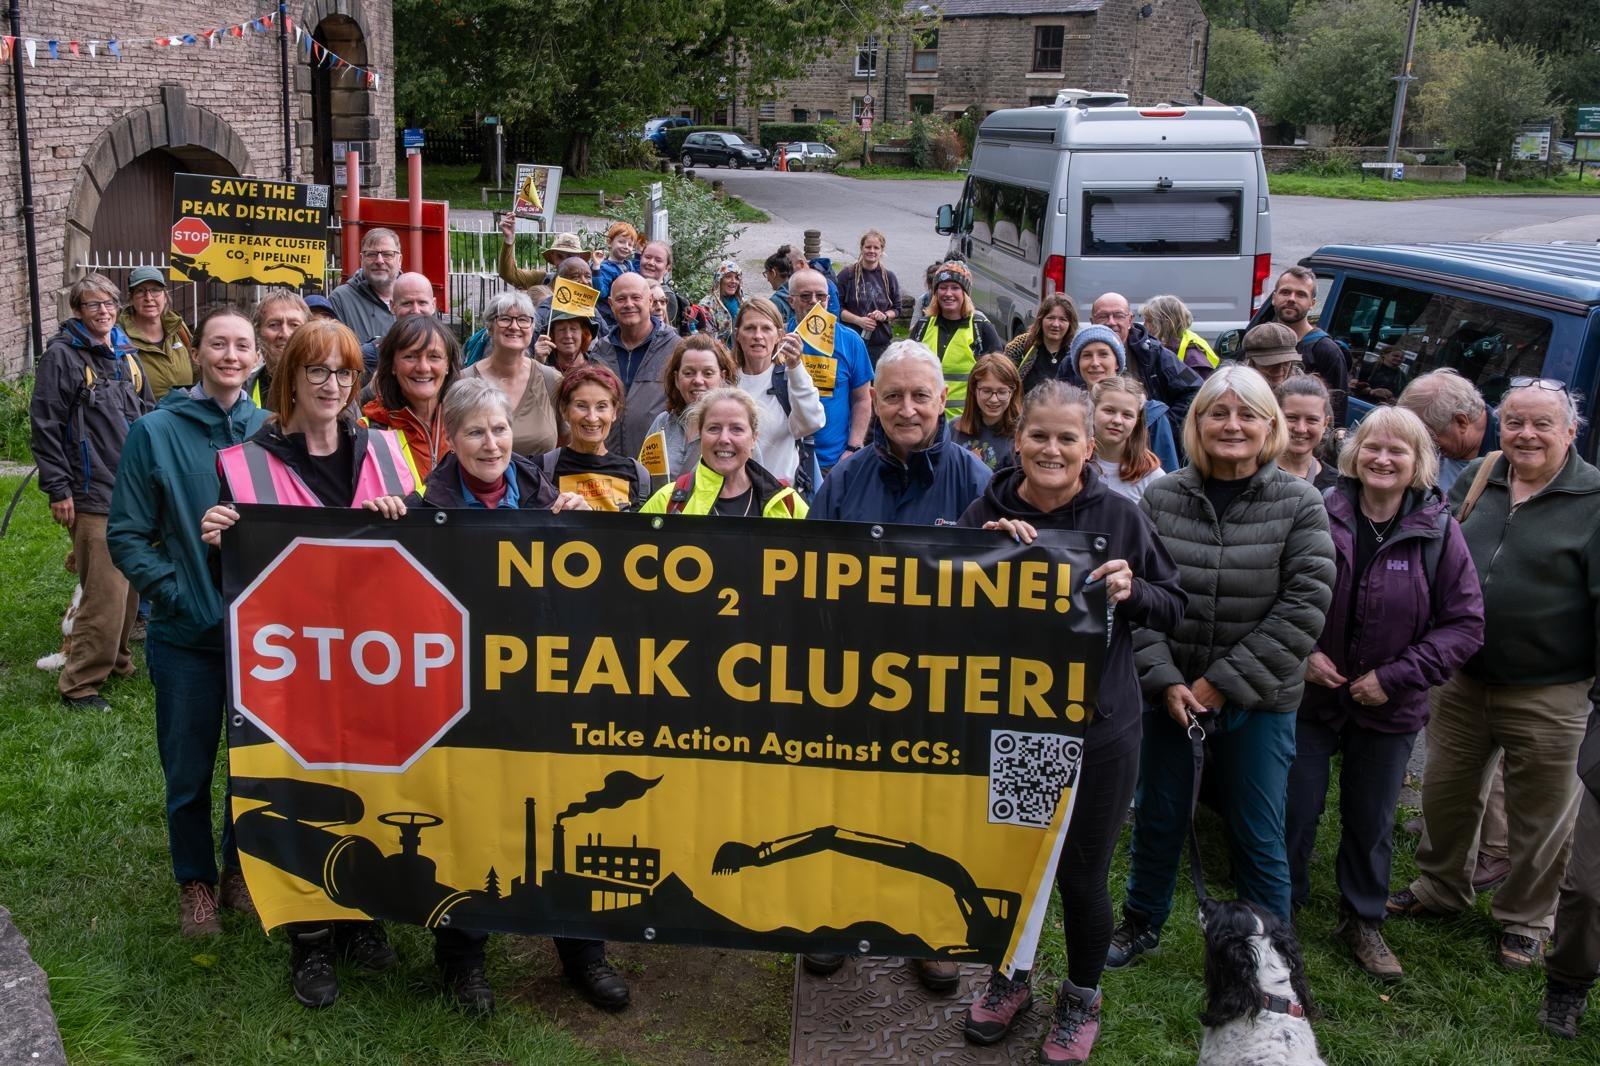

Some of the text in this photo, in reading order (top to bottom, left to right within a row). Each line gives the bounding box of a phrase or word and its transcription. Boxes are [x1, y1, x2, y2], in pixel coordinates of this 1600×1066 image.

[210, 179, 296, 200] SAVE THE
[181, 200, 321, 224] PEAK DISTRICT!
[174, 230, 209, 242] STOP
[212, 233, 326, 251] THE PEAK CLUSTER
[252, 251, 312, 264] PIPELINE!
[645, 443, 659, 451] NO!
[498, 540, 602, 589] NO
[762, 548, 1071, 614] PIPELINE!
[249, 623, 455, 687] STOP
[484, 634, 1086, 723] PEAK CLUSTER!
[571, 722, 960, 766] Take Action Against CCS:
